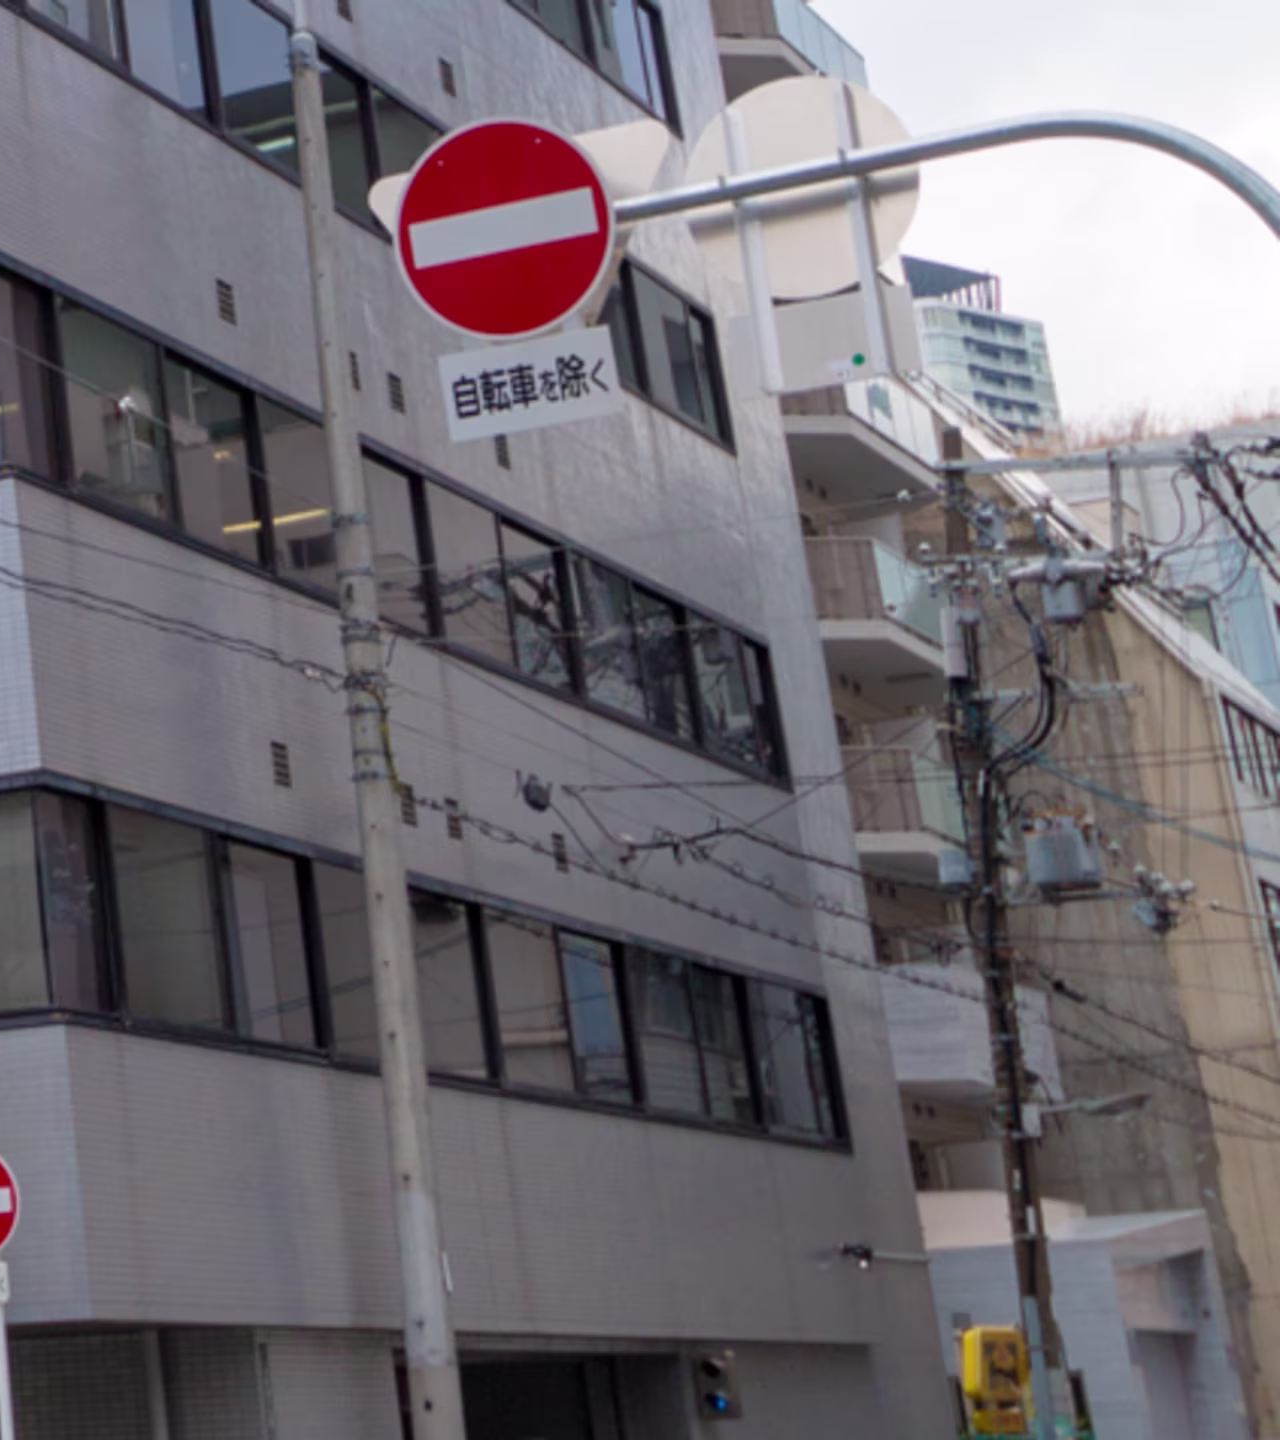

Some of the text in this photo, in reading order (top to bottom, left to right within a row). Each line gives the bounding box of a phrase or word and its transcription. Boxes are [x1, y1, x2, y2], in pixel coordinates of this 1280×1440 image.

[451, 354, 609, 421] 自転車を除く
